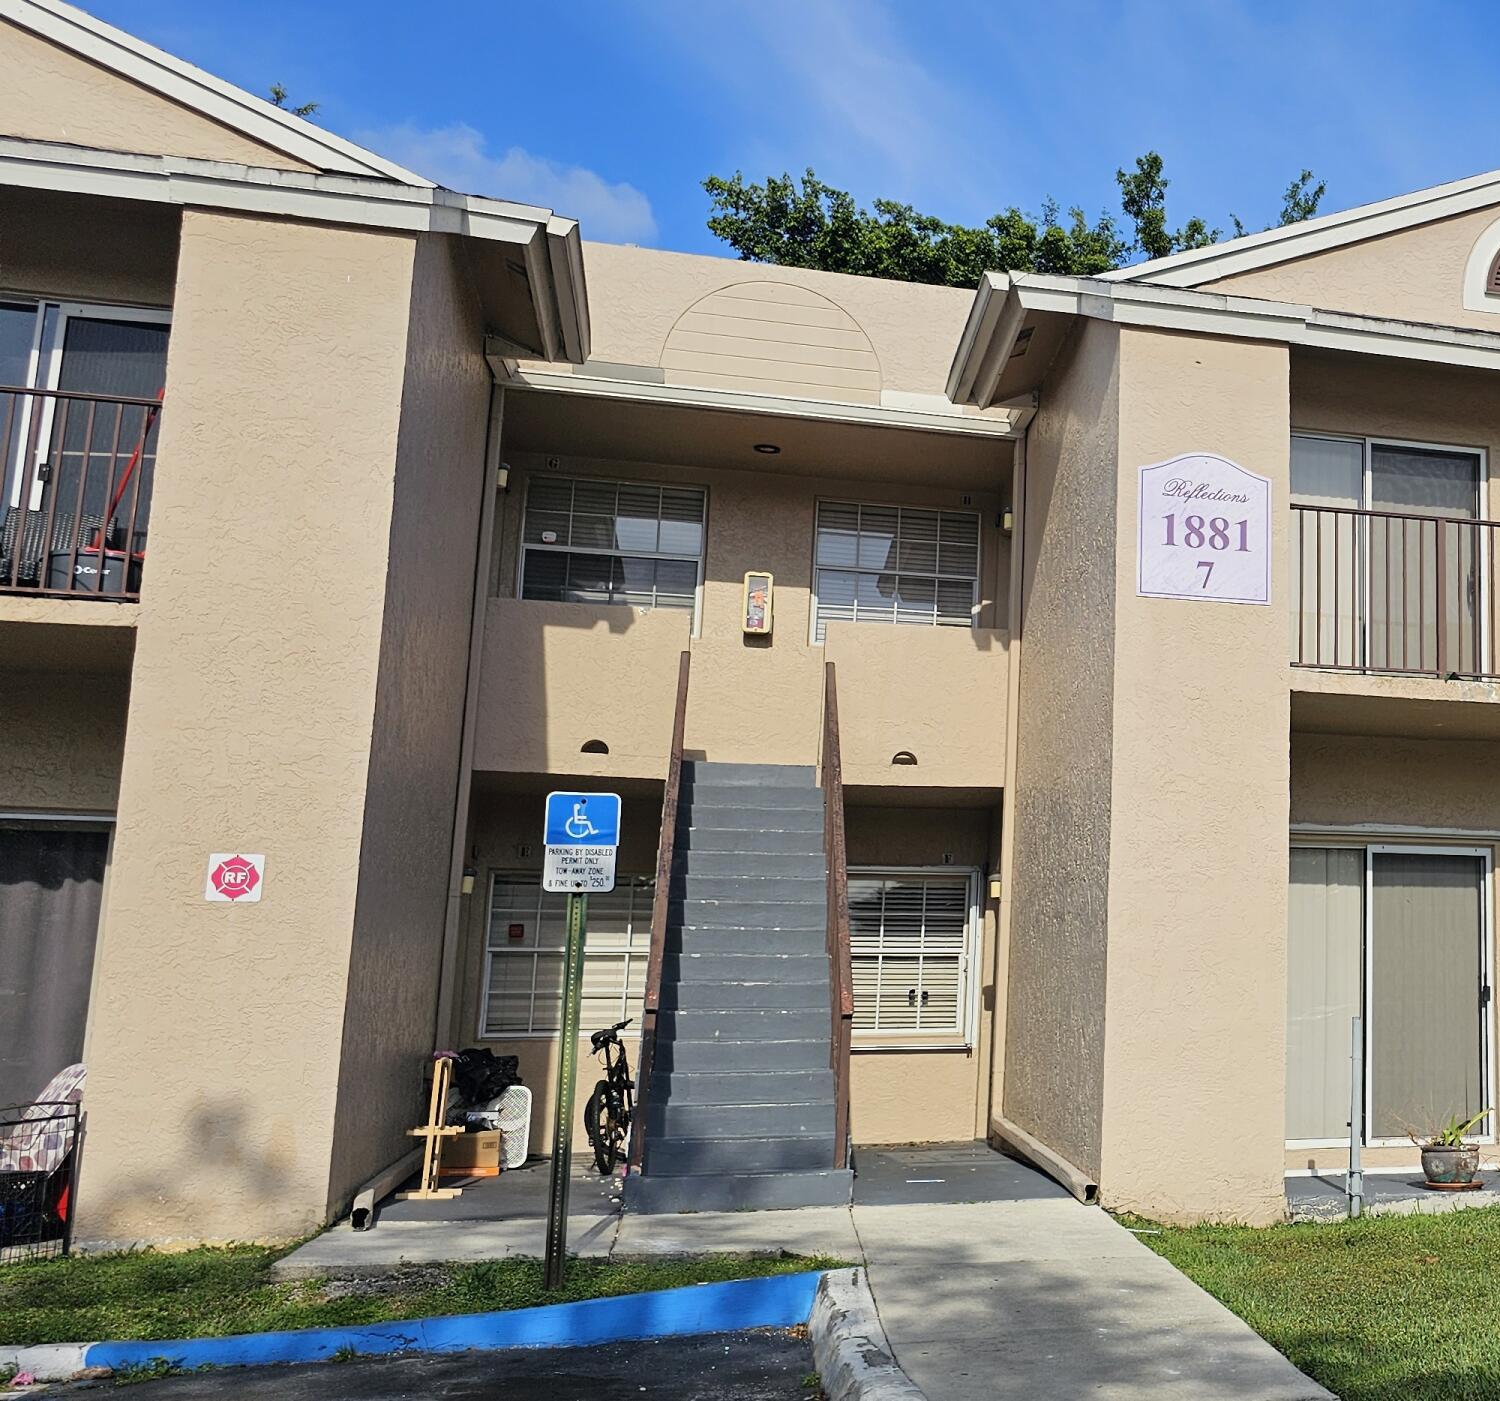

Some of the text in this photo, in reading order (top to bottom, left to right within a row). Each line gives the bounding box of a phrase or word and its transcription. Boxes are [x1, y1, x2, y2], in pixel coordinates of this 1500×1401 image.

[1162, 477, 1250, 503] Reflections
[1161, 513, 1252, 552] 1881
[1196, 560, 1215, 589] 7
[575, 848, 583, 856] BY
[585, 848, 613, 856] DISABLED
[224, 871, 247, 884] RF
[556, 867, 604, 875] TOW-AWAY ZONE
